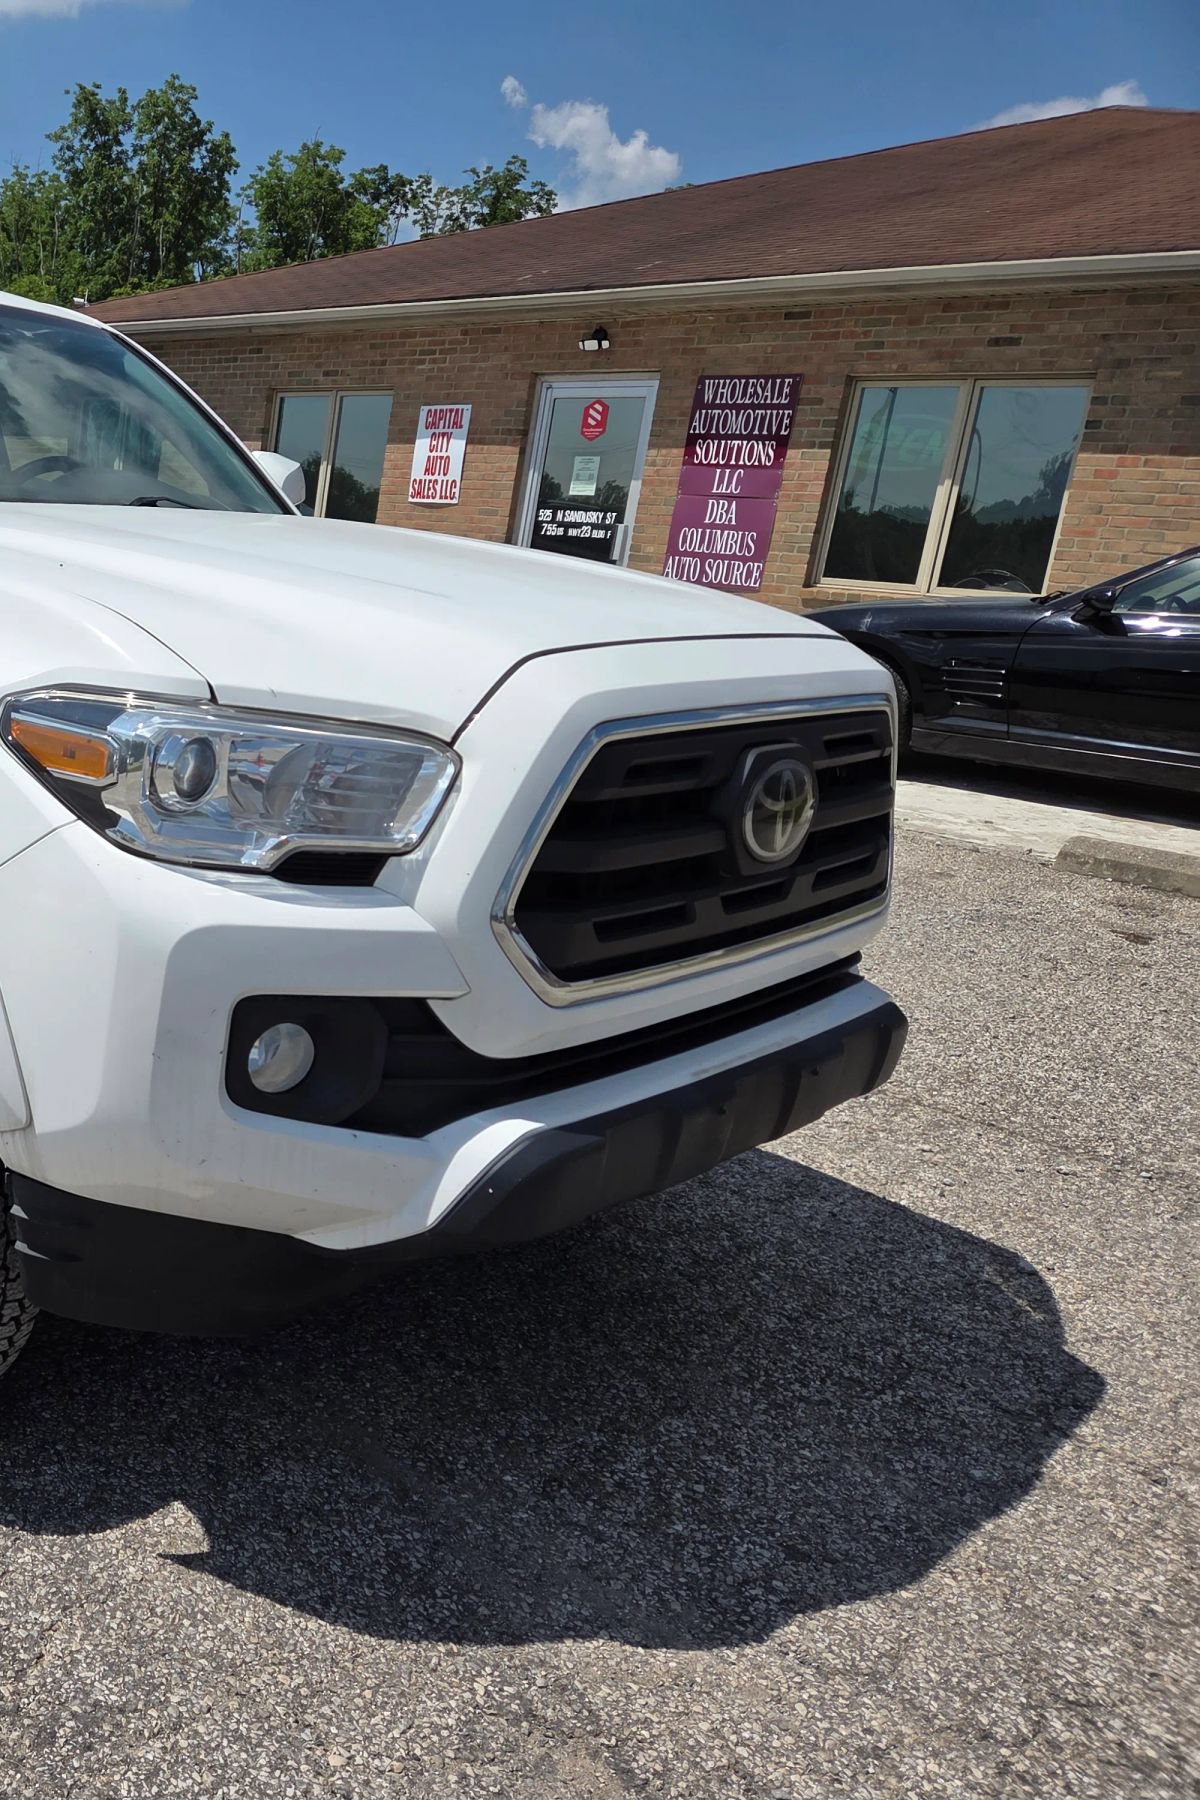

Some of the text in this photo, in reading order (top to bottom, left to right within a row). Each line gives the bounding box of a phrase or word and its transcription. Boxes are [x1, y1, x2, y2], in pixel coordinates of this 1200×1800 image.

[704, 378, 792, 404] WHOLESALE
[424, 408, 464, 430] CAPITAL
[689, 409, 792, 435] AUTOMOTIVE
[429, 431, 453, 453] CITY
[693, 439, 776, 466] SOLUTIONS
[423, 455, 451, 477] AUTO
[410, 478, 438, 500] SALES
[712, 468, 744, 494] LLC
[538, 509, 618, 525] 525 N SANDUSKY ST
[704, 499, 737, 525] DBA
[540, 523, 557, 536] 755
[678, 527, 757, 556] COLUMBUS
[663, 555, 763, 588] AUTO SOURCE
